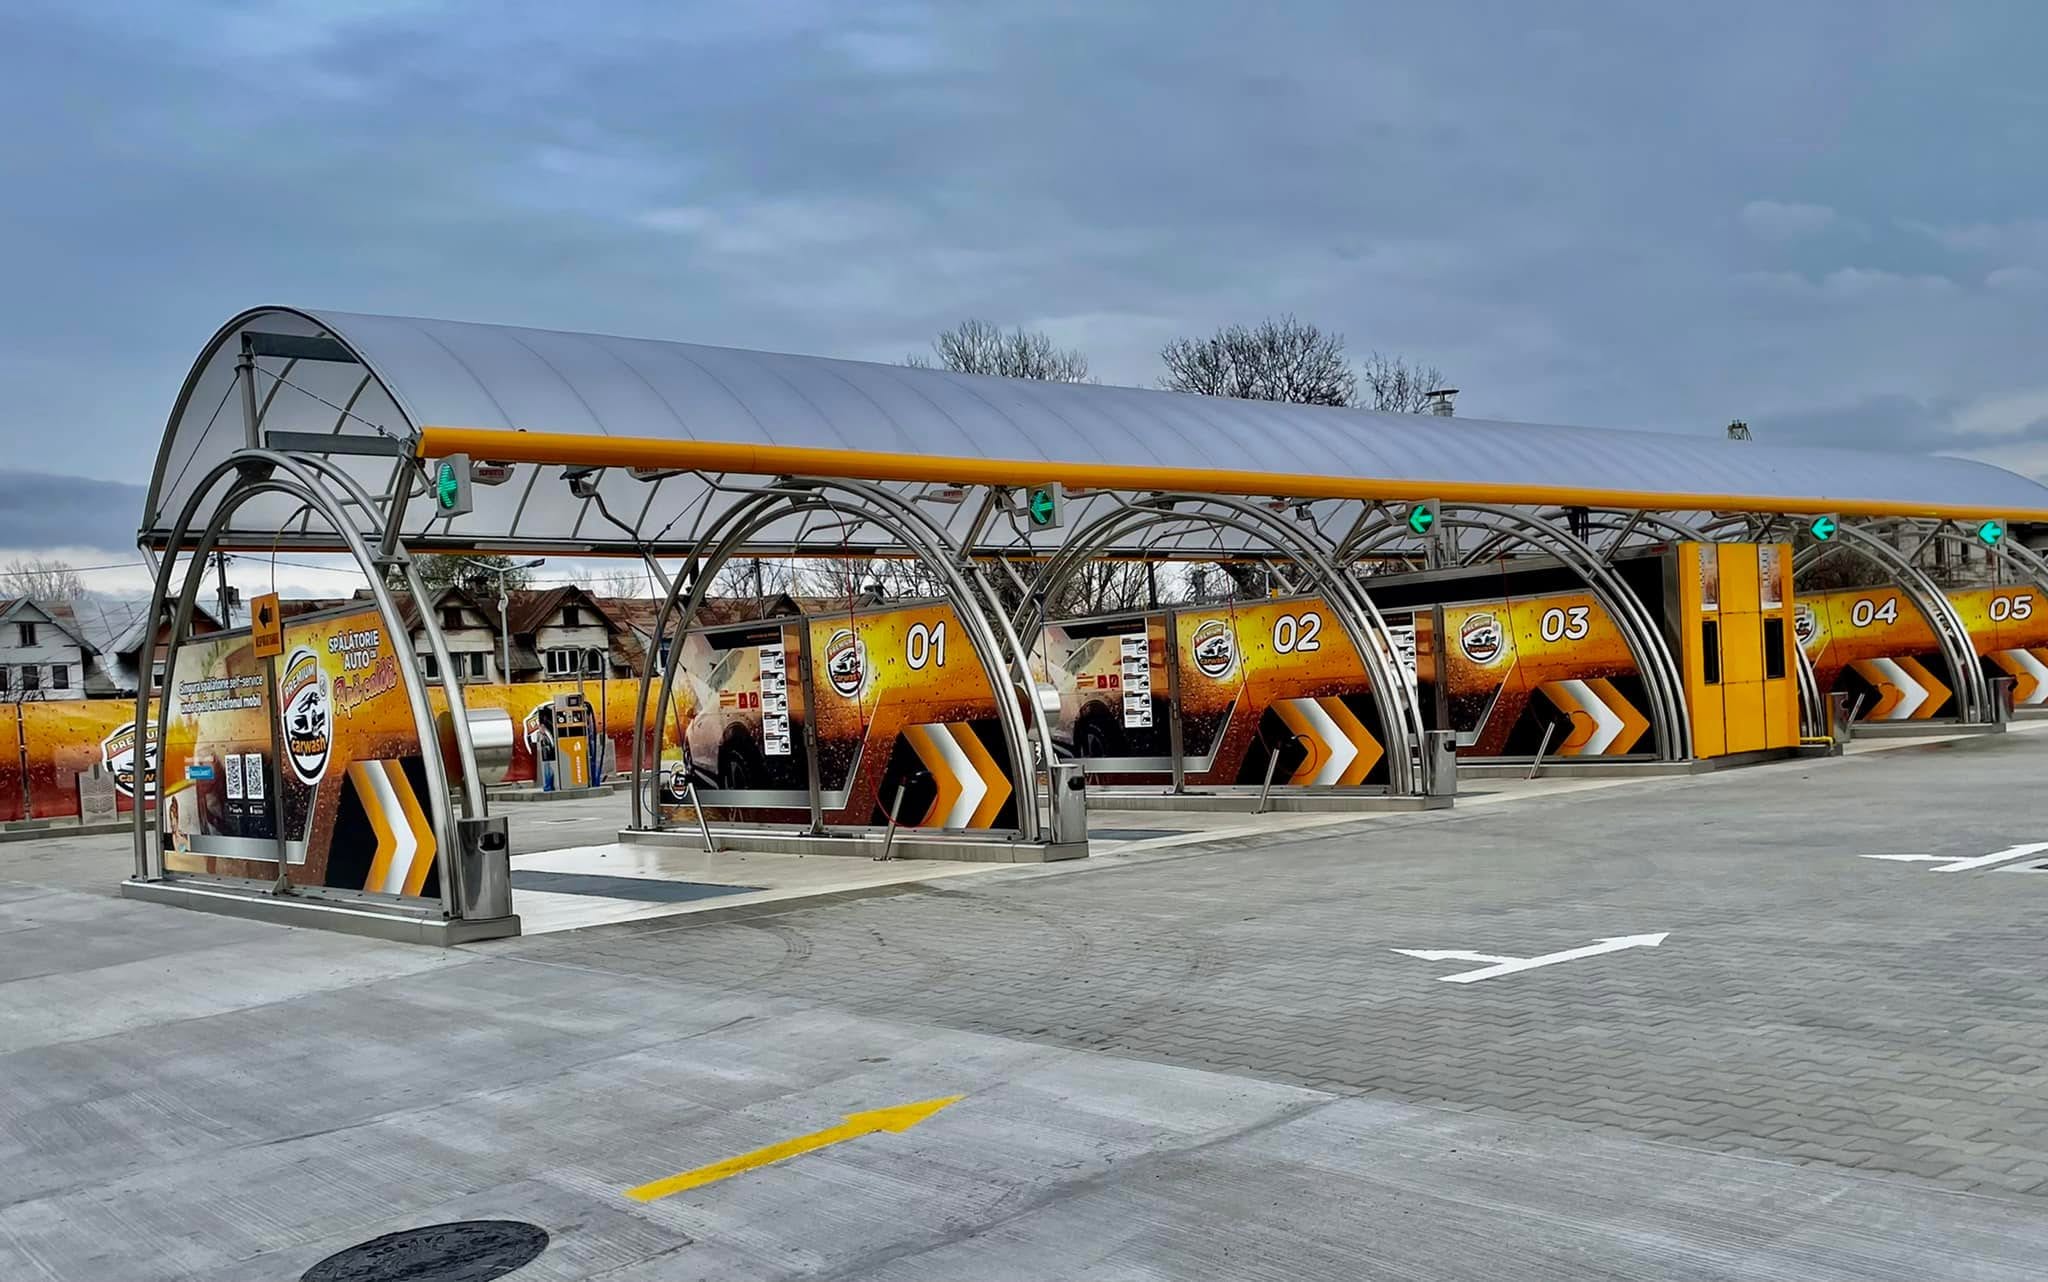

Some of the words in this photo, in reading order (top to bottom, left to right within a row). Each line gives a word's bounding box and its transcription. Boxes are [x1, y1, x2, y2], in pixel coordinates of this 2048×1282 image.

[1541, 605, 1590, 642] 03
[1852, 597, 1898, 628] 04
[1989, 594, 2033, 622] 05
[906, 621, 945, 670] 01
[1273, 612, 1322, 654] 02
[344, 649, 370, 671] AUTO
[286, 664, 315, 695] PREMIUM
[291, 735, 327, 754] carwash
